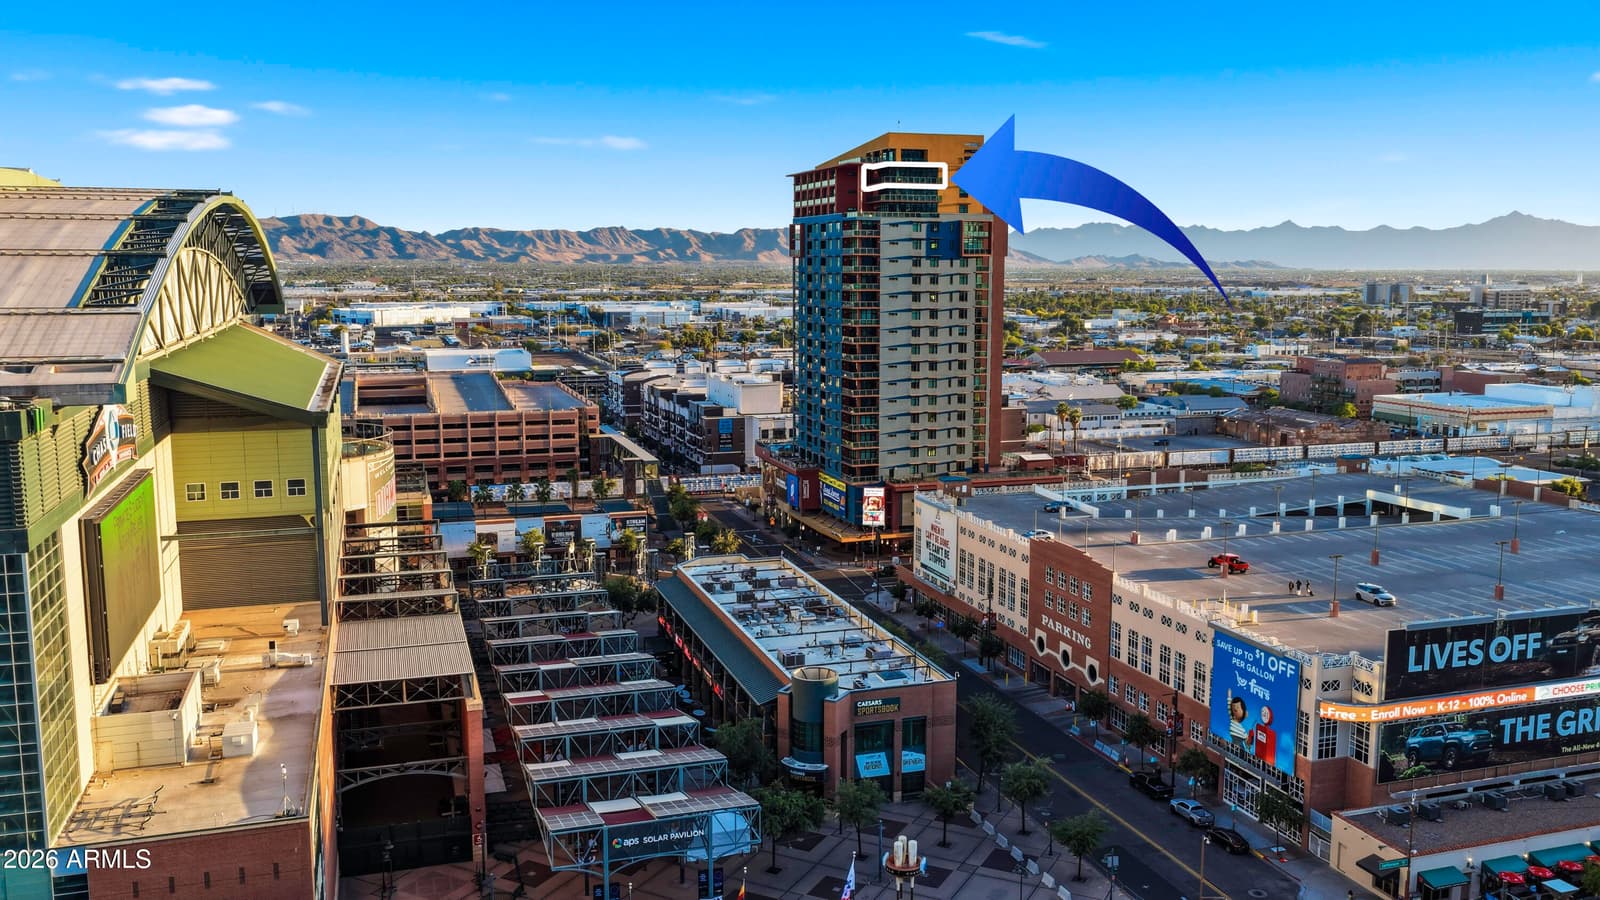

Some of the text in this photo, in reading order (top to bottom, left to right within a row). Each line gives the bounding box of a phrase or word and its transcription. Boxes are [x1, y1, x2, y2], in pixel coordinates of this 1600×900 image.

[930, 524, 940, 534] WHEN
[935, 534, 940, 544] BE
[926, 540, 932, 551] WE
[944, 550, 950, 560] BE
[929, 552, 946, 568] STOPPED
[1042, 614, 1091, 649] PARKING
[1216, 640, 1296, 678] SAVE UP TO $1 OFF
[1408, 632, 1542, 672] LIVES OFF
[1232, 657, 1274, 682] PER GALLON
[858, 704, 899, 716] SPORTSBOOK
[1371, 708, 1400, 720] Enroll
[1403, 705, 1426, 716] Now
[1437, 700, 1460, 712] K-12
[1468, 695, 1494, 707] 100%
[1497, 692, 1527, 704] Online
[1500, 713, 1551, 744] THE
[1572, 744, 1595, 752] All-New
[623, 829, 704, 847] aps SOLAR PAVILION
